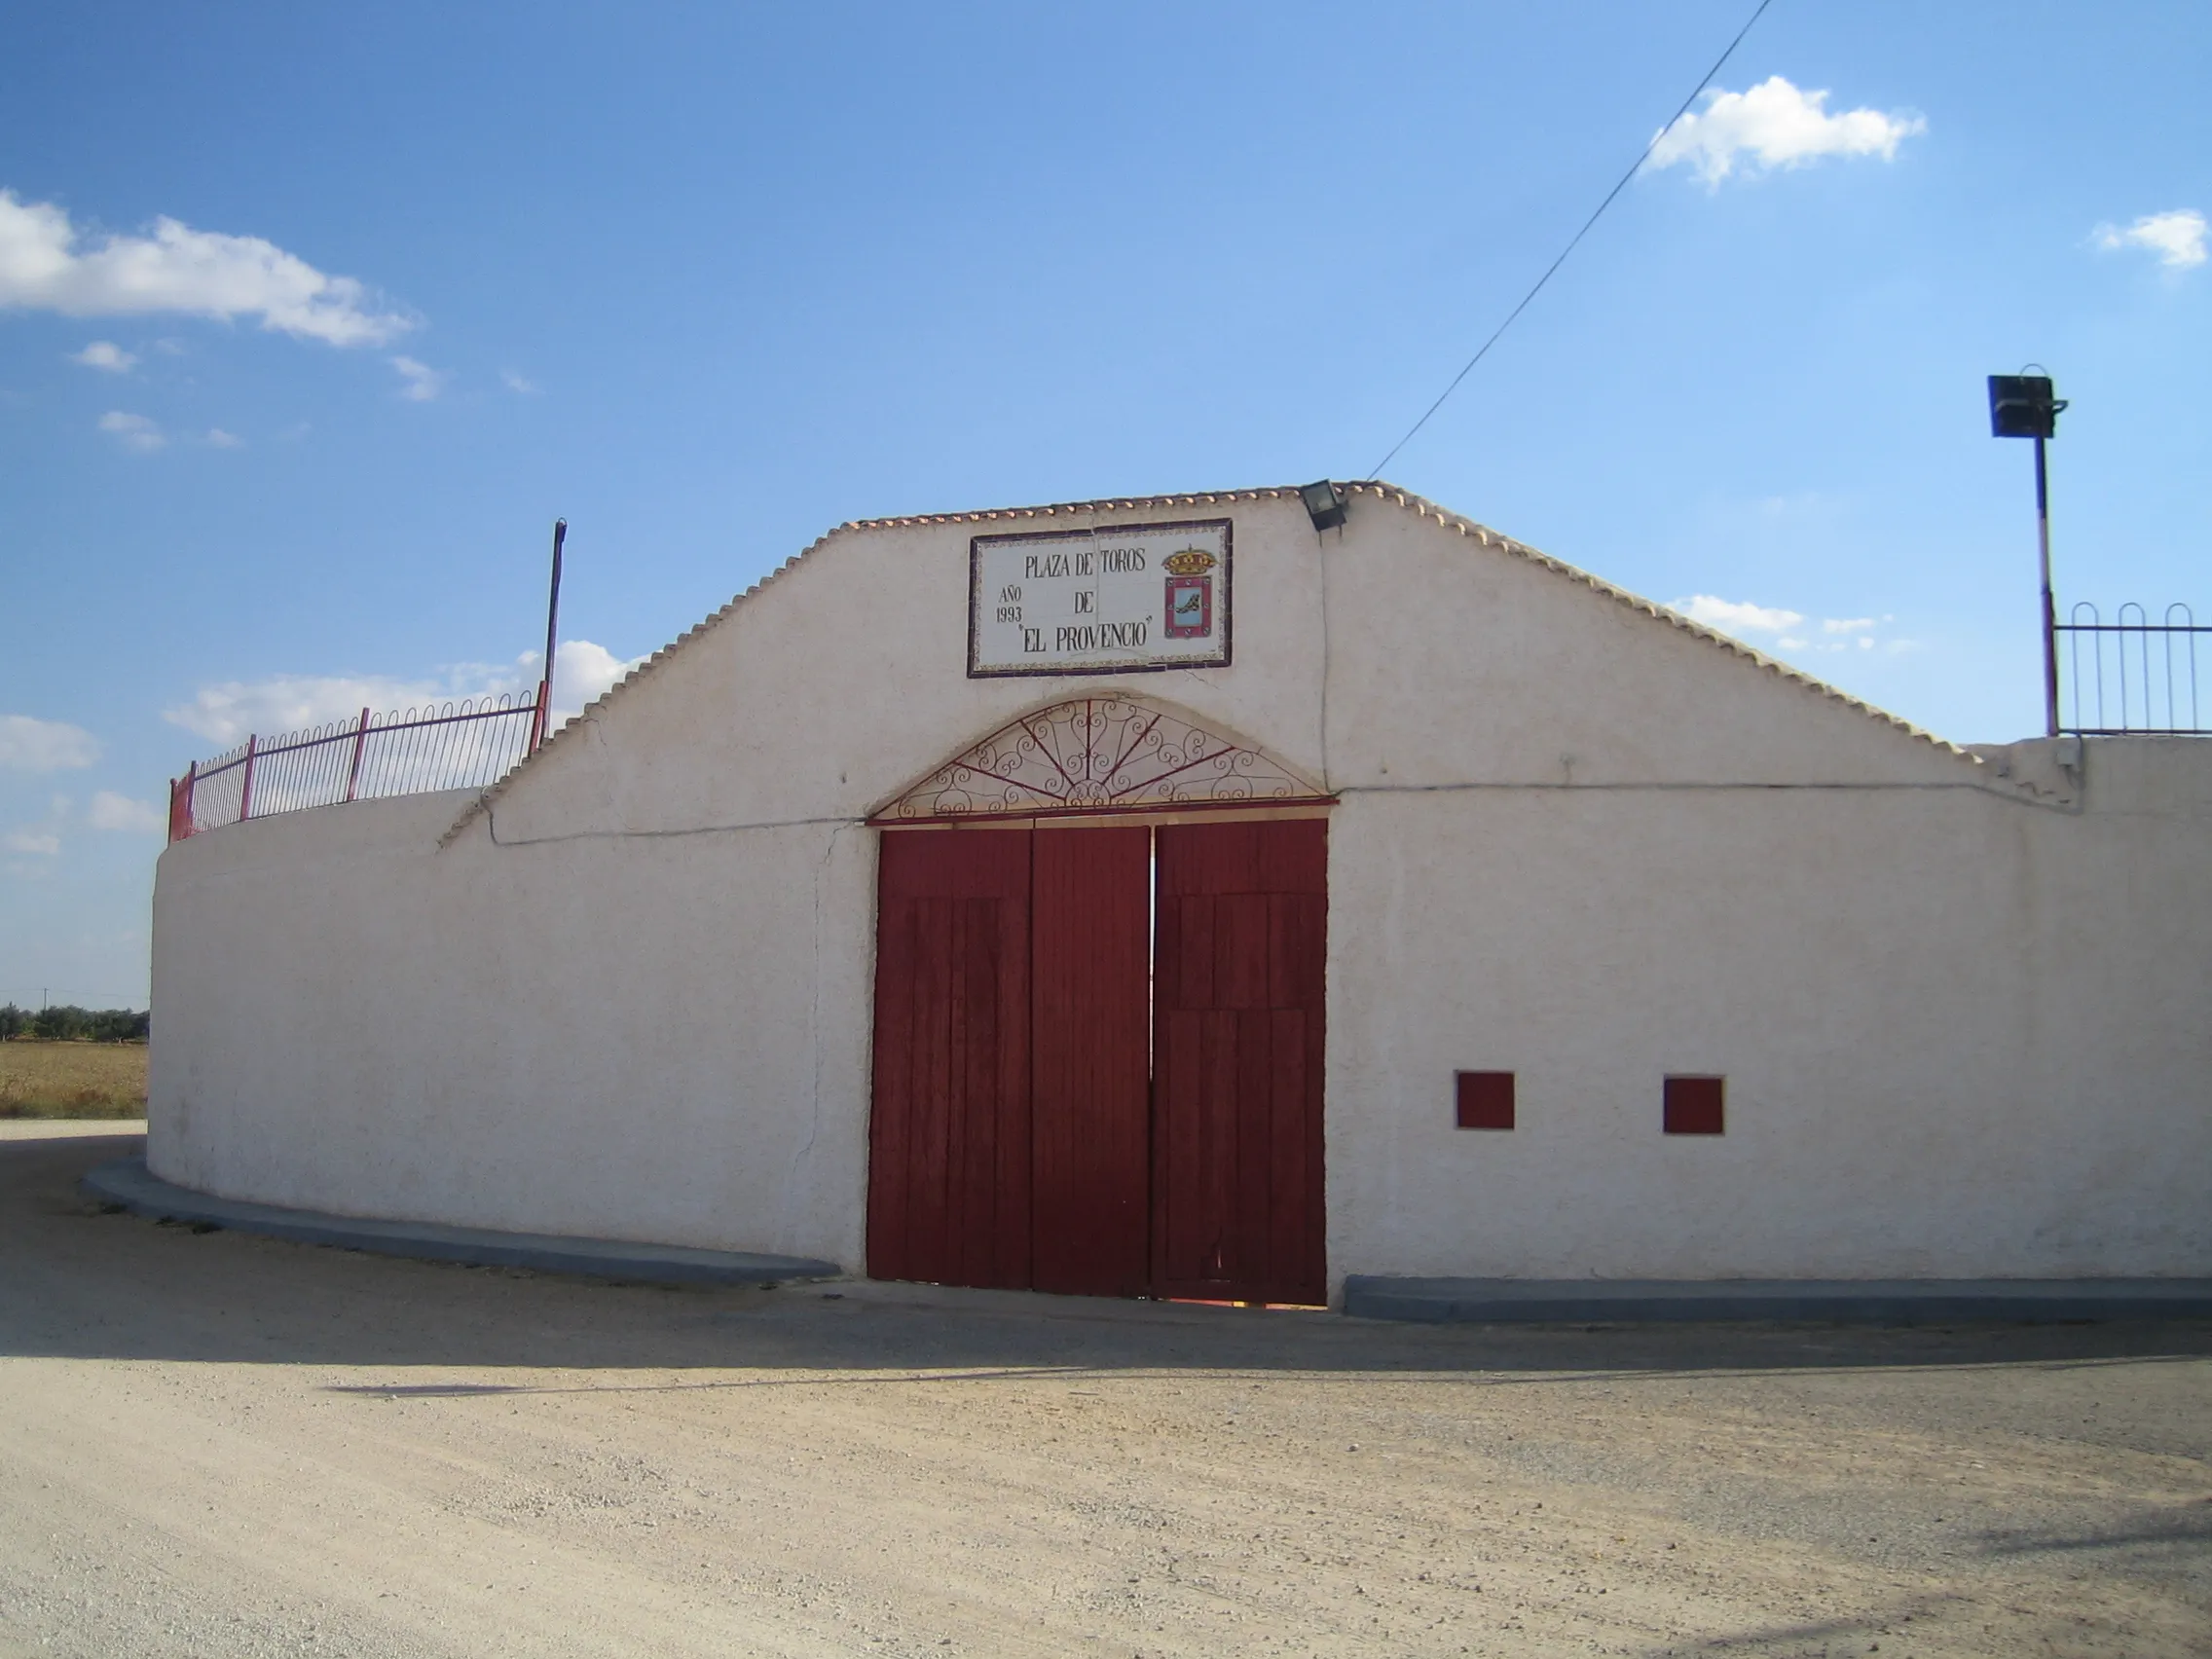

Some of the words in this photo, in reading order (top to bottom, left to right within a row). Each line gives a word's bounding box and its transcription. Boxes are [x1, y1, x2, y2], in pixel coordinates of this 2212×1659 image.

[1025, 553, 1070, 579] PLAZA
[1075, 552, 1093, 576] DE
[1100, 548, 1146, 573] TOROS
[999, 584, 1021, 603] AÑO
[1074, 591, 1093, 614] DE
[996, 607, 1022, 623] 1993
